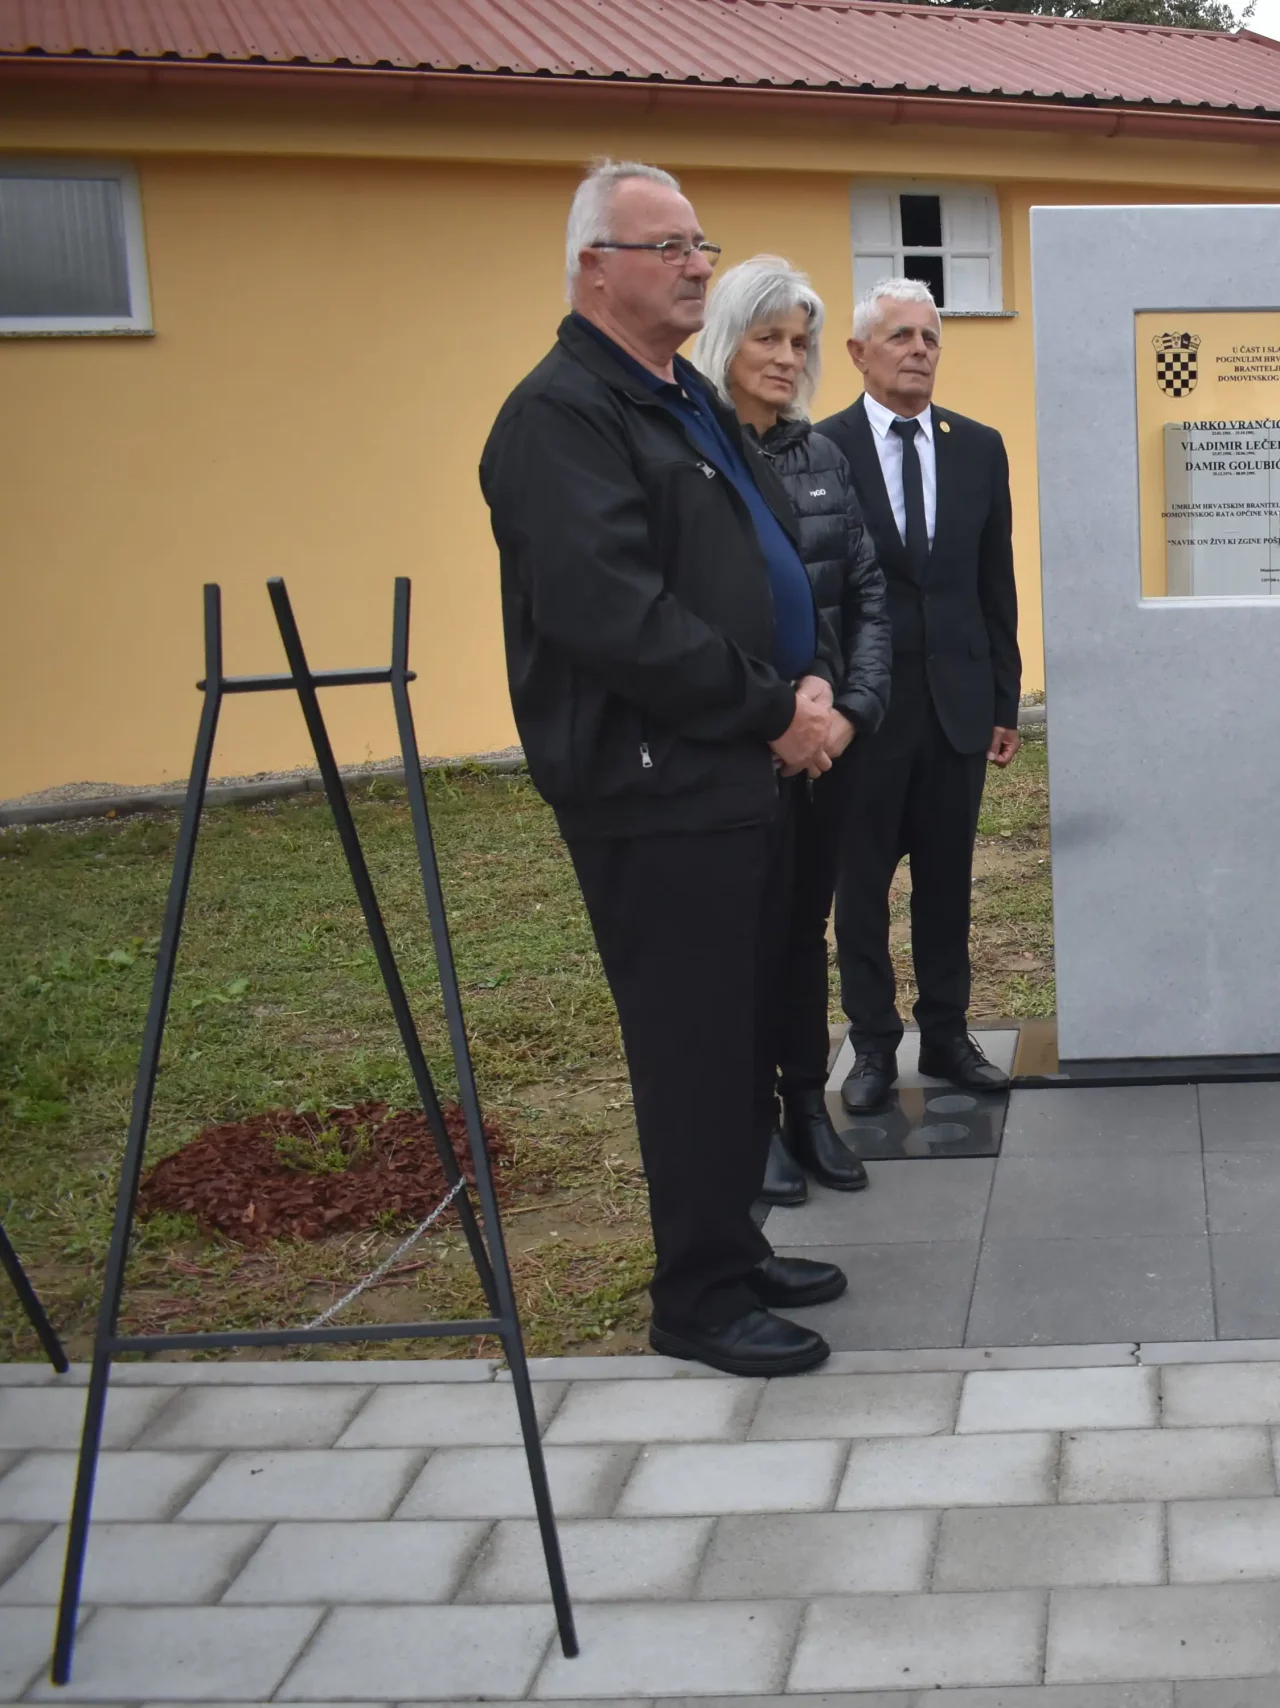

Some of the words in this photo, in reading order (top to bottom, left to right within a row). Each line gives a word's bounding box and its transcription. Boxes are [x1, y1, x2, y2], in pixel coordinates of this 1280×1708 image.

[1232, 346, 1238, 354] U
[1240, 345, 1260, 354] ČAST
[1183, 420, 1226, 430] DARKO
[1180, 441, 1243, 452] VLADIMIR
[1185, 461, 1226, 472] DAMIR
[1210, 536, 1226, 545] ŽIVI
